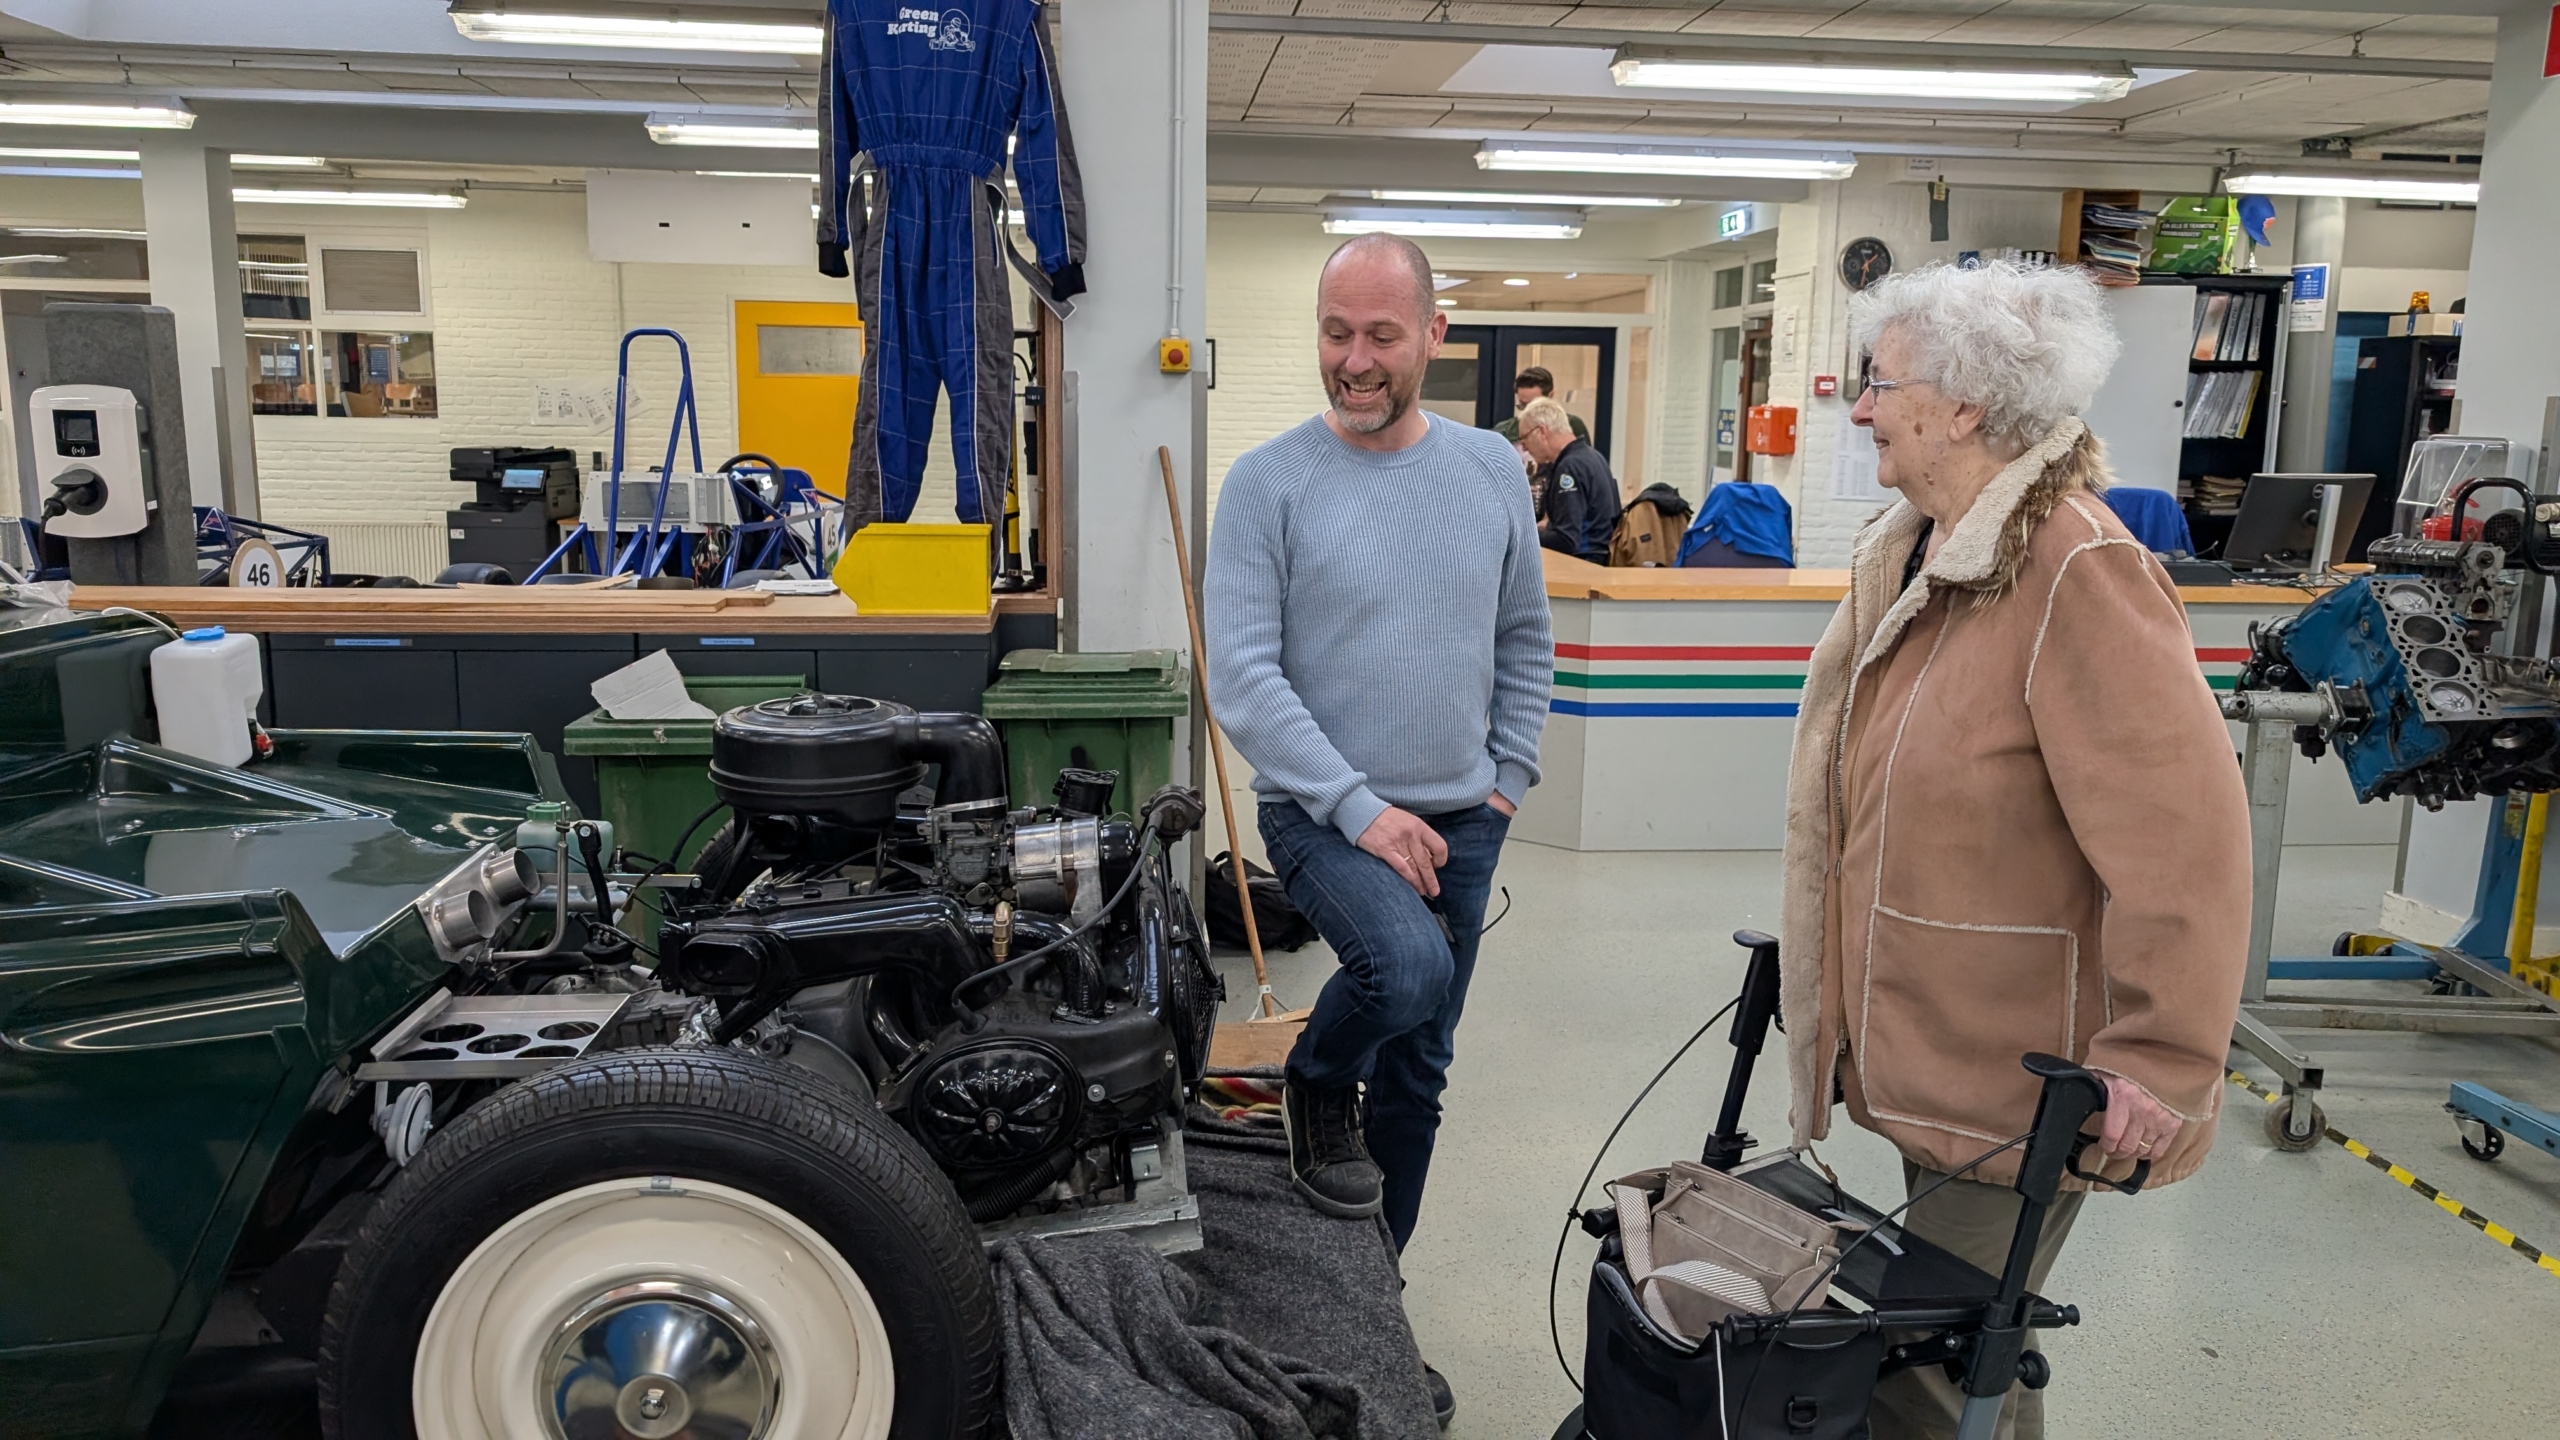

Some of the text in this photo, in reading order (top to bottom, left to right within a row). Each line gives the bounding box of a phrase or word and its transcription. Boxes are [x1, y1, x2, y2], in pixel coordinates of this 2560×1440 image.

[899, 7, 939, 21] Green
[827, 523, 836, 549] 45
[247, 563, 270, 587] 46
